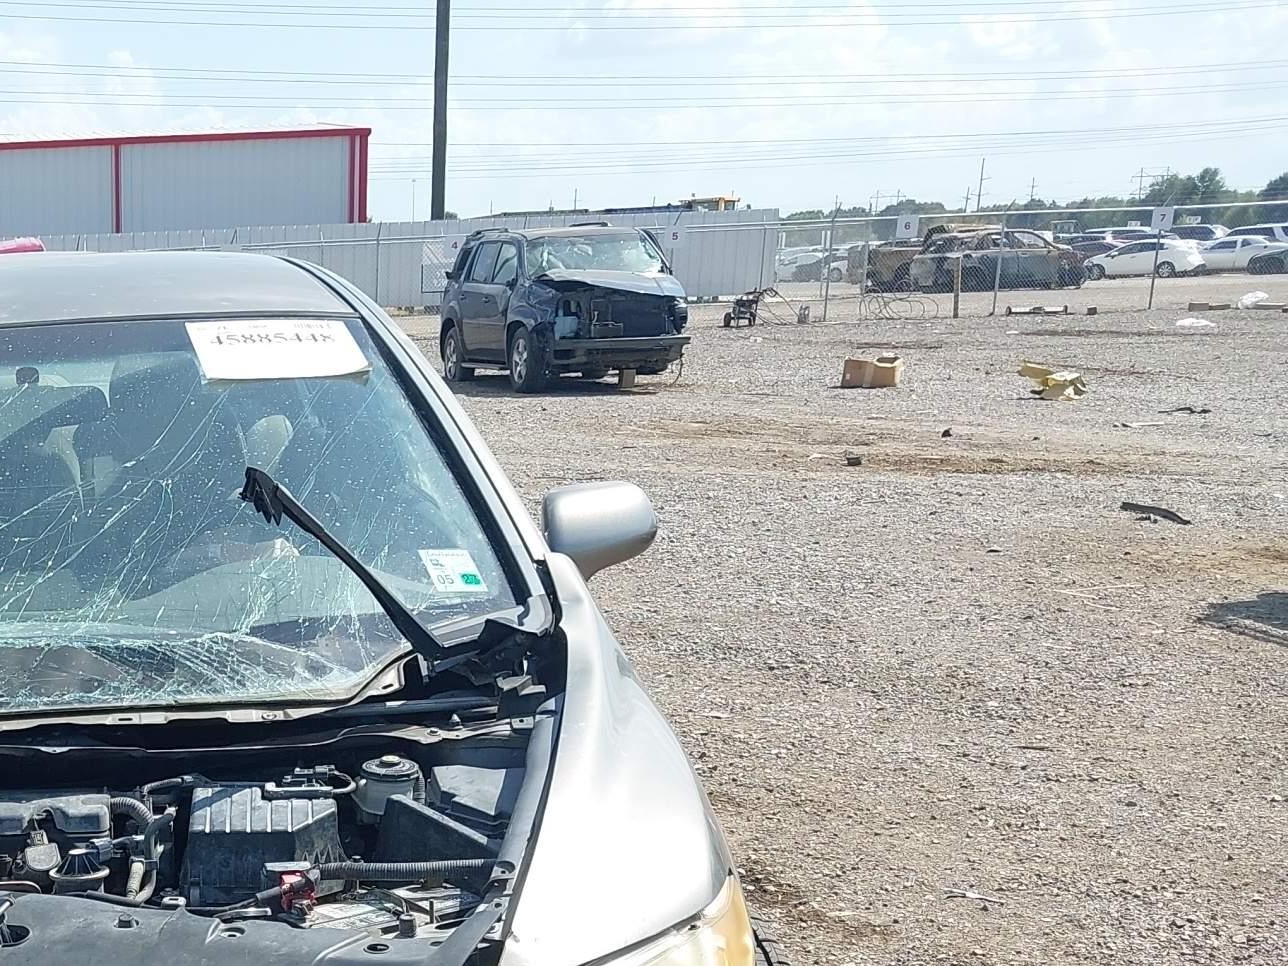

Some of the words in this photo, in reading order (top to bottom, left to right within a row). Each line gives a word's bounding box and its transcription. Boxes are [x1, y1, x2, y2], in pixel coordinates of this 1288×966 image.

[1160, 213, 1166, 222] 7
[904, 221, 911, 230] 6
[672, 232, 679, 241] 5
[451, 241, 458, 249] 4
[436, 574, 454, 585] 05
